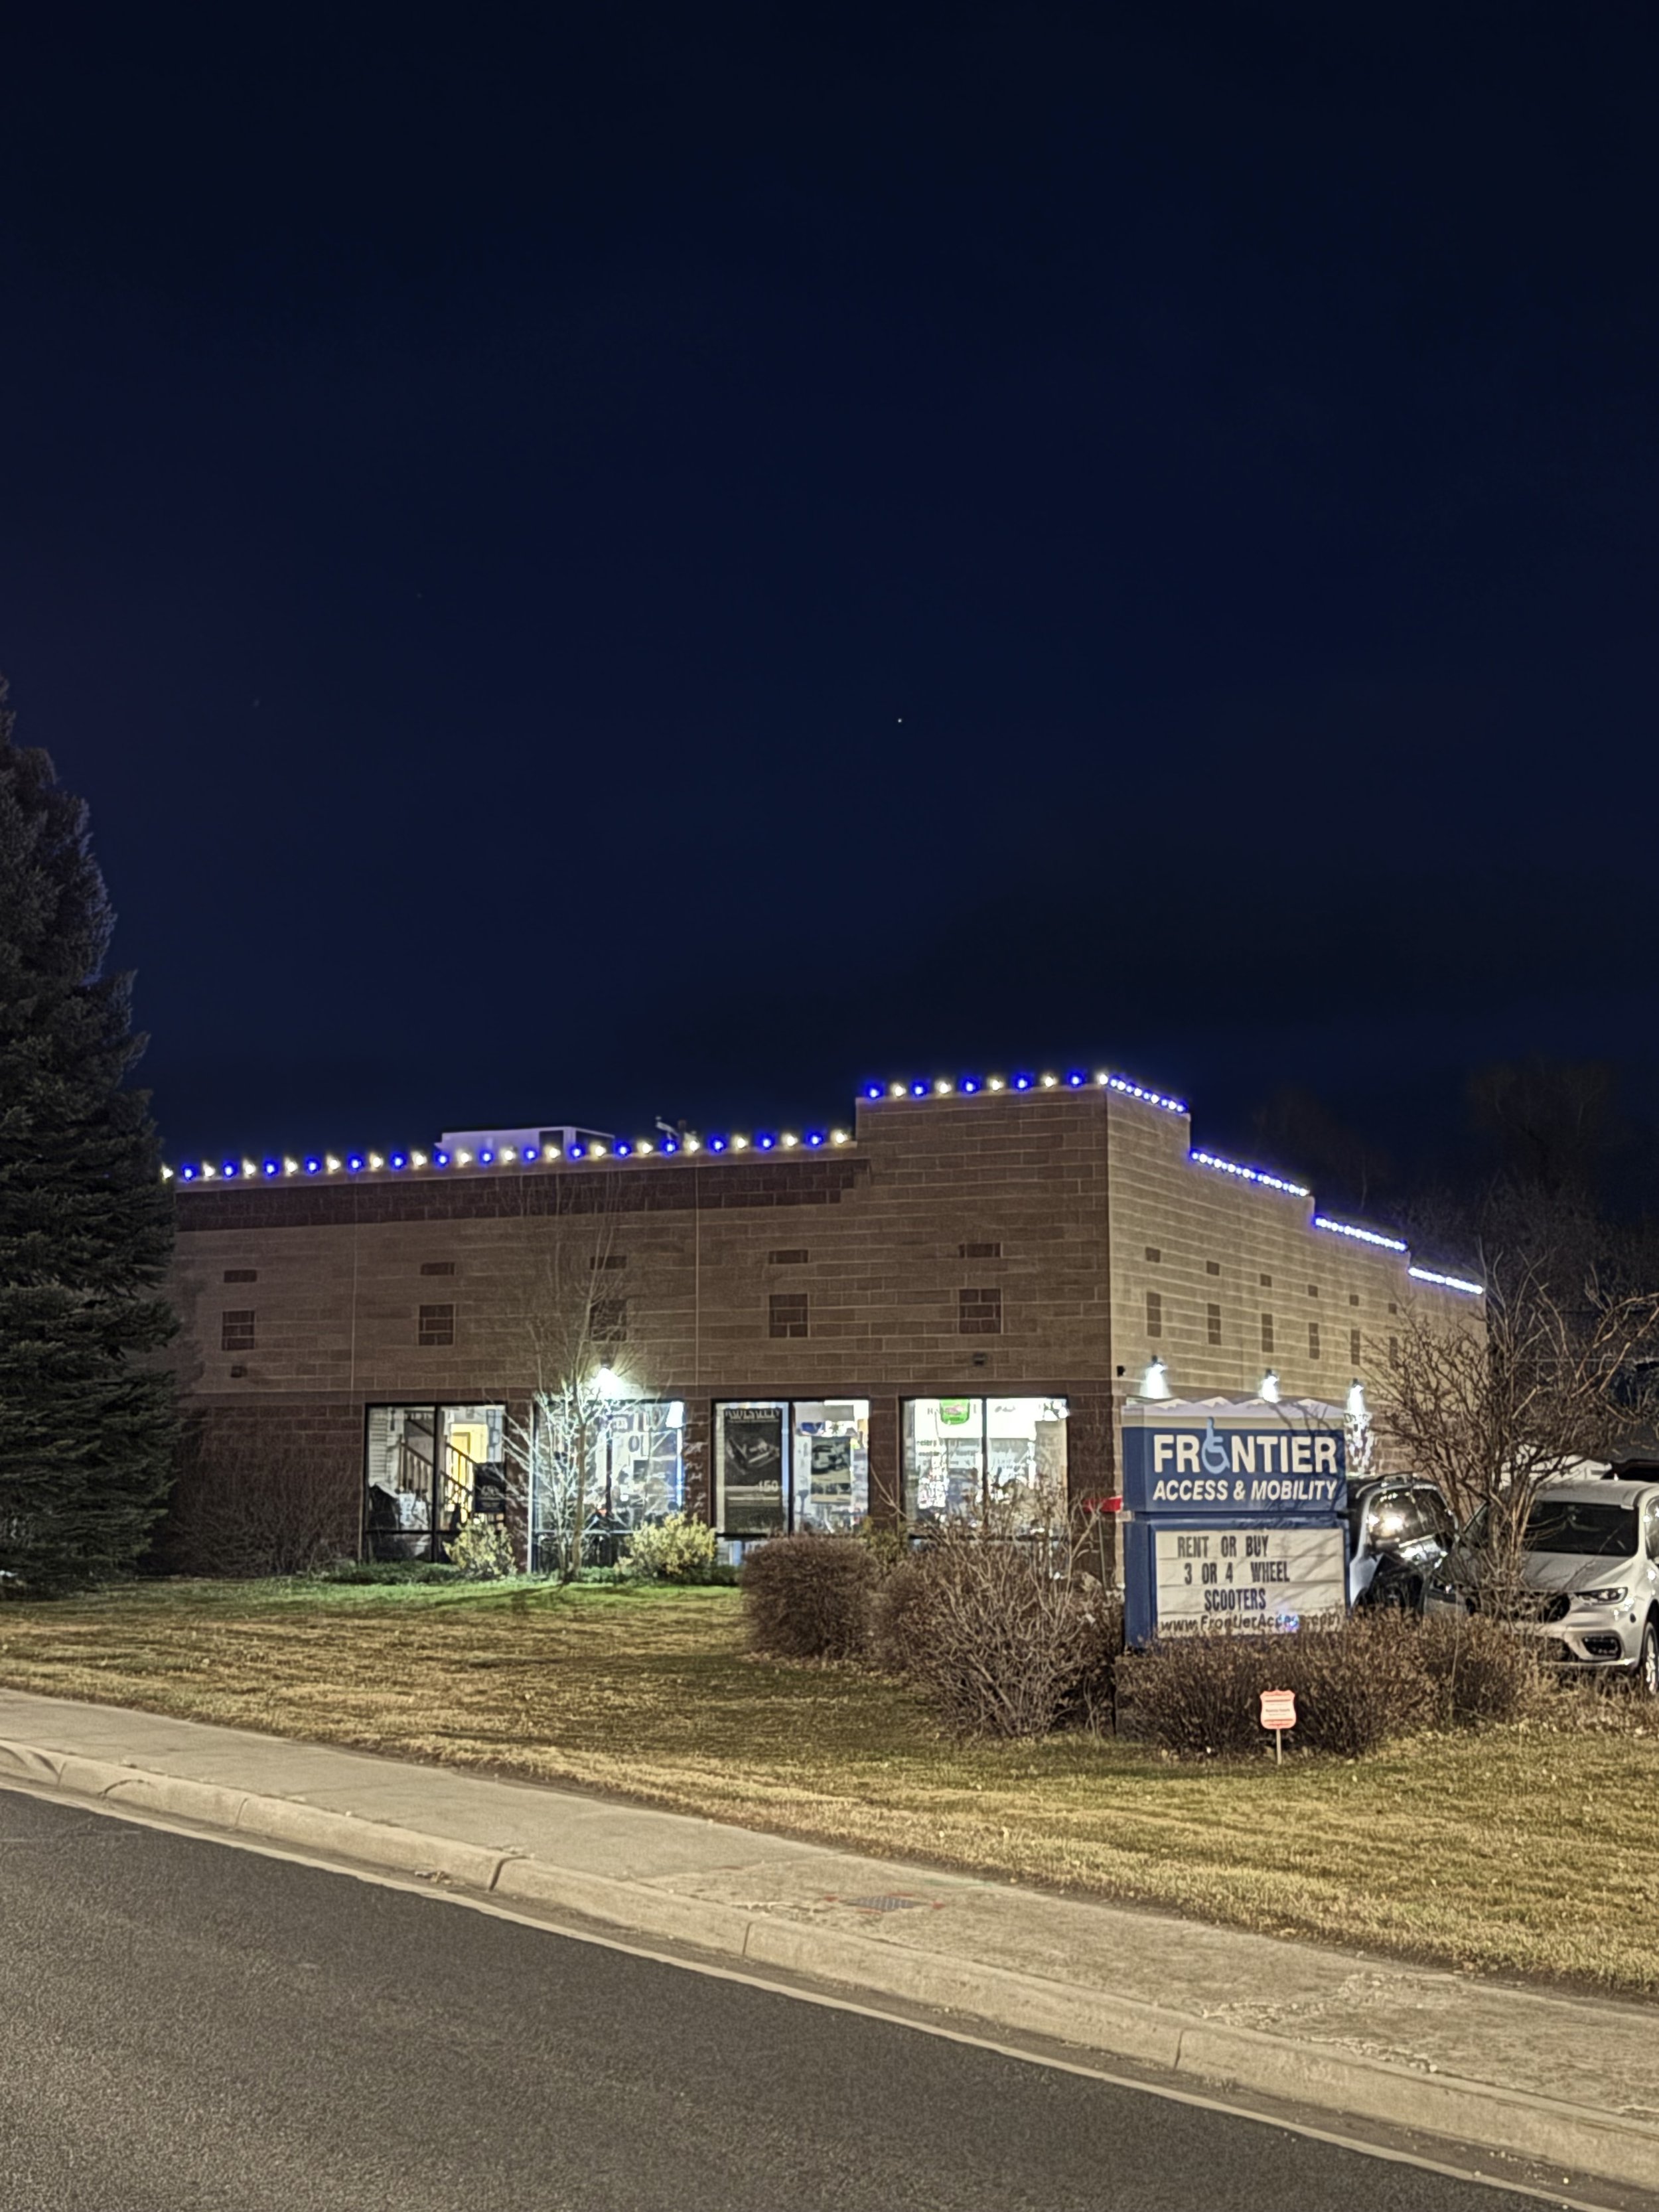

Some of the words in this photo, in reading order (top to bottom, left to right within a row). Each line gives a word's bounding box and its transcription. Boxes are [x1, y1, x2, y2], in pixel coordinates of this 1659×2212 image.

[1153, 1479, 1228, 1501] ACCESS
[1233, 1480, 1246, 1501] &
[1250, 1479, 1337, 1501] MOBILITY
[1177, 1536, 1209, 1558] RENT
[1220, 1535, 1237, 1558] OR
[1246, 1535, 1269, 1558] BUY
[1184, 1562, 1192, 1585] 3
[1201, 1562, 1218, 1585] OR
[1225, 1562, 1234, 1584] 4
[1250, 1560, 1290, 1584] WHEEL
[1204, 1587, 1267, 1612] SCOOTERS
